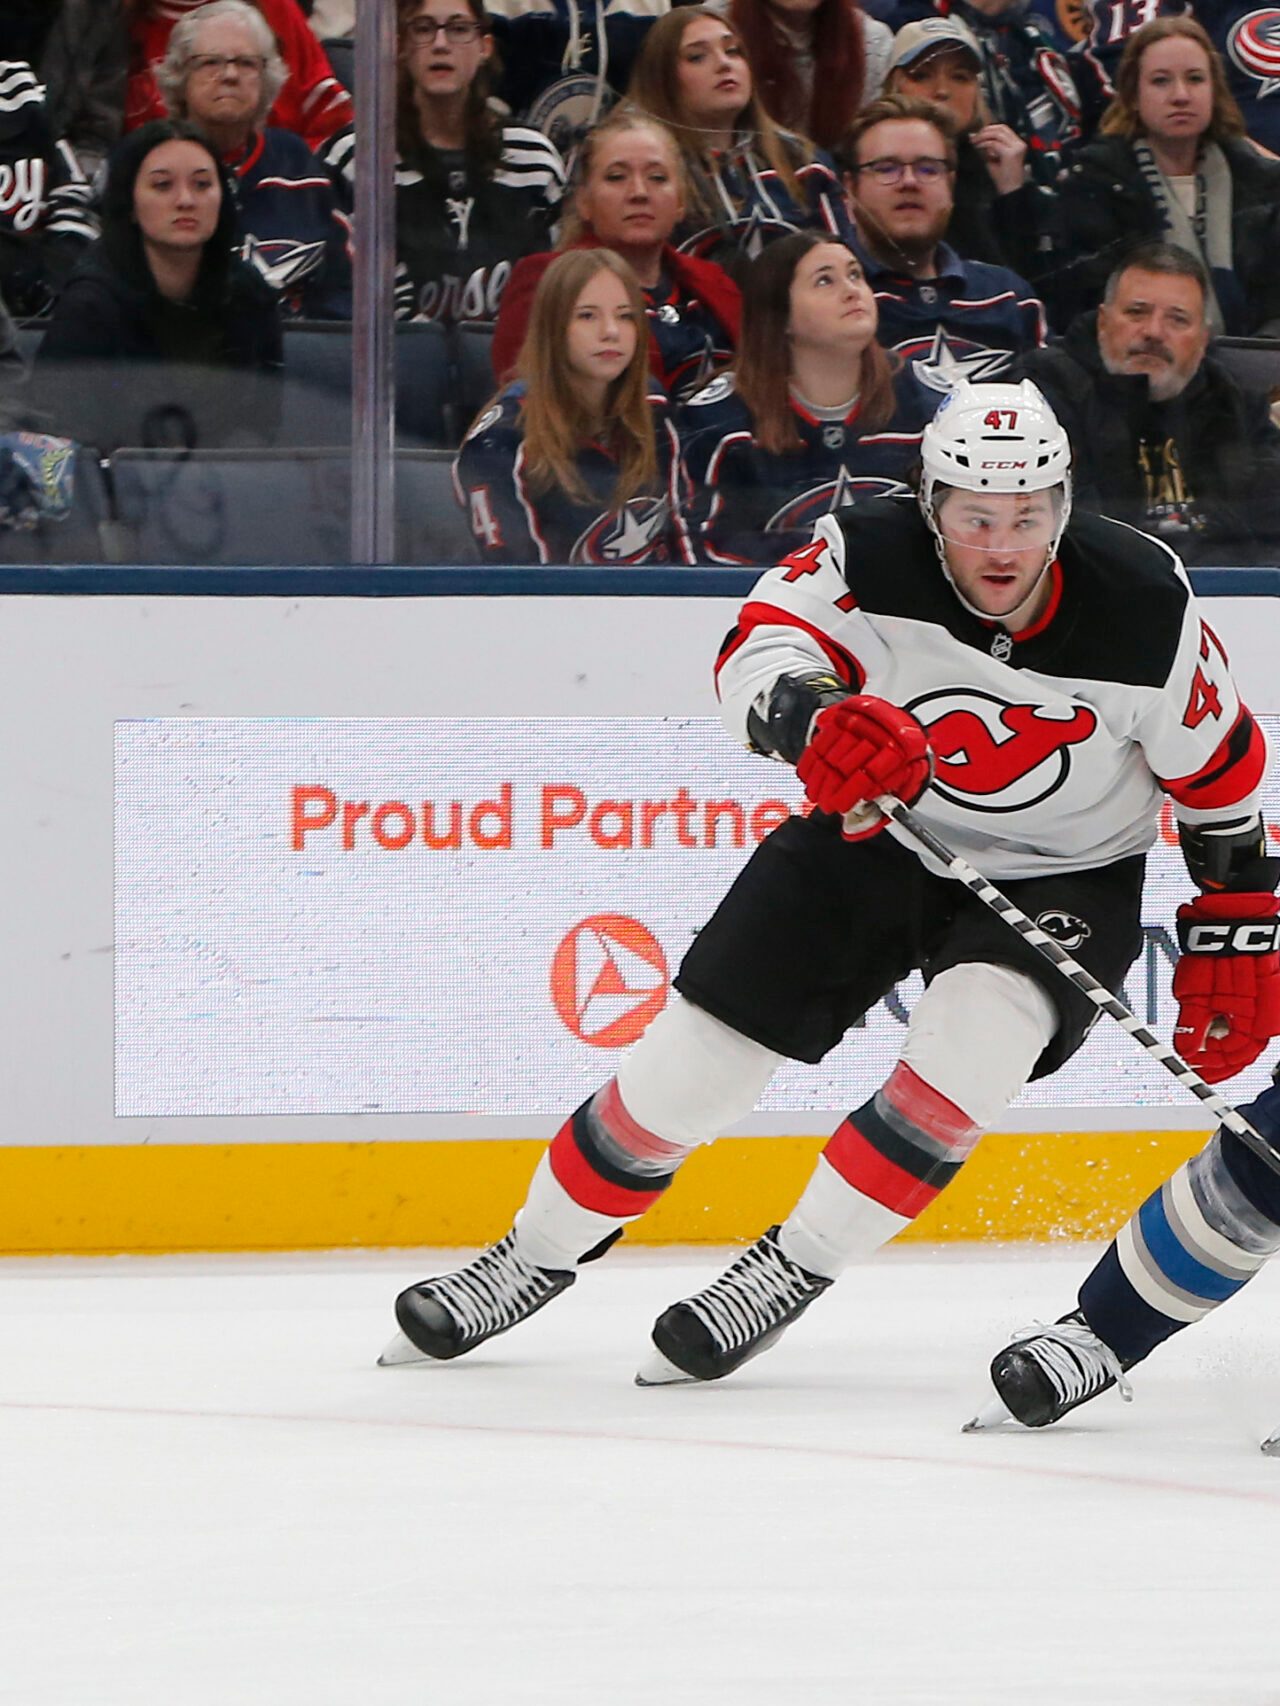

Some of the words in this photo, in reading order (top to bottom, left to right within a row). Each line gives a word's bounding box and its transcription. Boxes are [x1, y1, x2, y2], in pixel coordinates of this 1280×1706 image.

[983, 409, 1019, 431] 47
[980, 460, 1029, 470] CCM
[469, 484, 505, 549] 4
[1181, 615, 1230, 730] 47
[292, 781, 513, 850] Proud
[1174, 1026, 1195, 1034] CM
